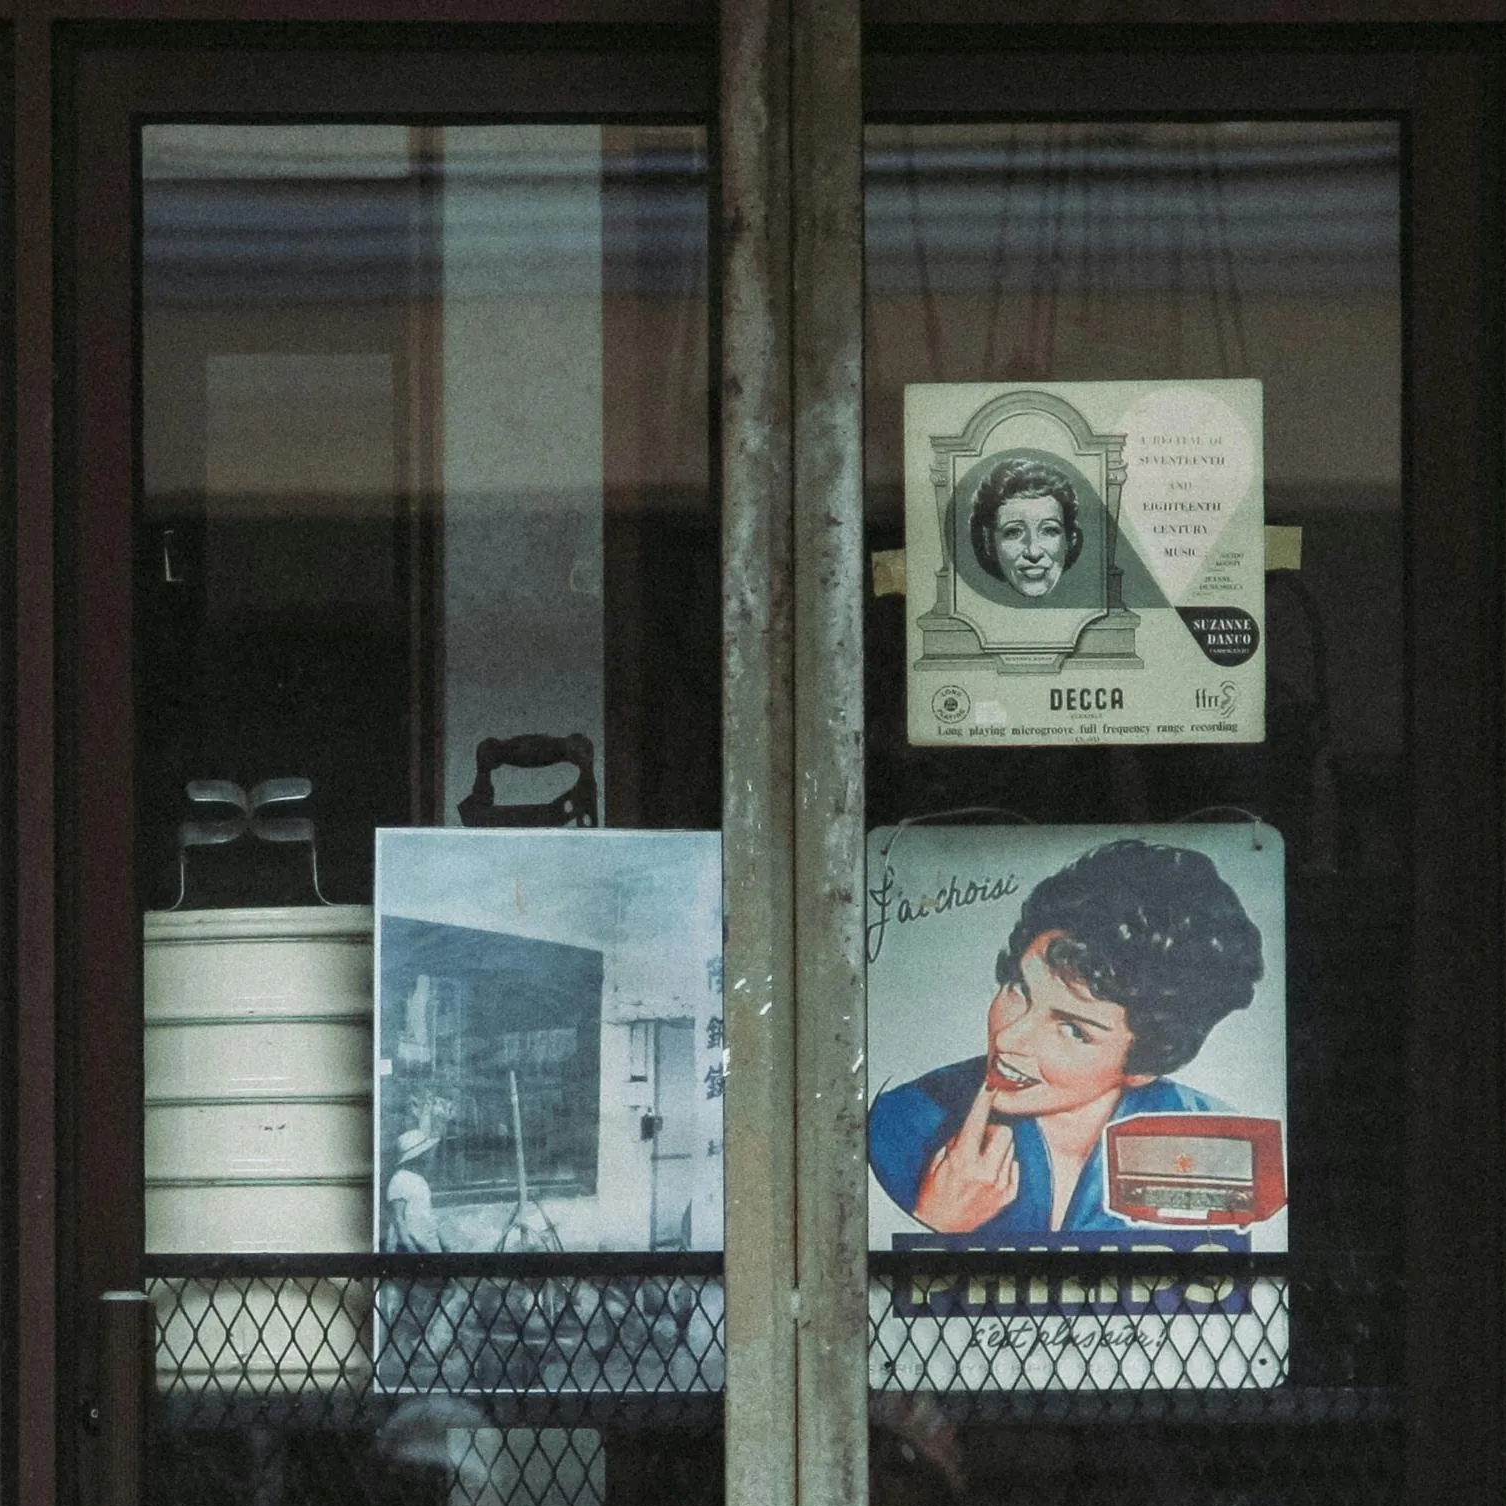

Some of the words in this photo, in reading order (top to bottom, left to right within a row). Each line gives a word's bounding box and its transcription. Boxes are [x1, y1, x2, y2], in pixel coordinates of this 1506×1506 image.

[1142, 501, 1222, 512] EIGHTEENTH
[1153, 524, 1208, 535] CENTURY
[1164, 547, 1197, 558] MUSIC
[1193, 618, 1252, 630] SUZANNE
[1207, 633, 1252, 645] DANCO
[1050, 687, 1124, 711] DECCA
[937, 725, 964, 737] Long
[969, 724, 1007, 737] playing
[1011, 724, 1074, 736] microgroove
[1080, 721, 1097, 734] full
[1102, 722, 1151, 736] frequency
[1156, 724, 1185, 735] range
[1190, 720, 1238, 734] recording
